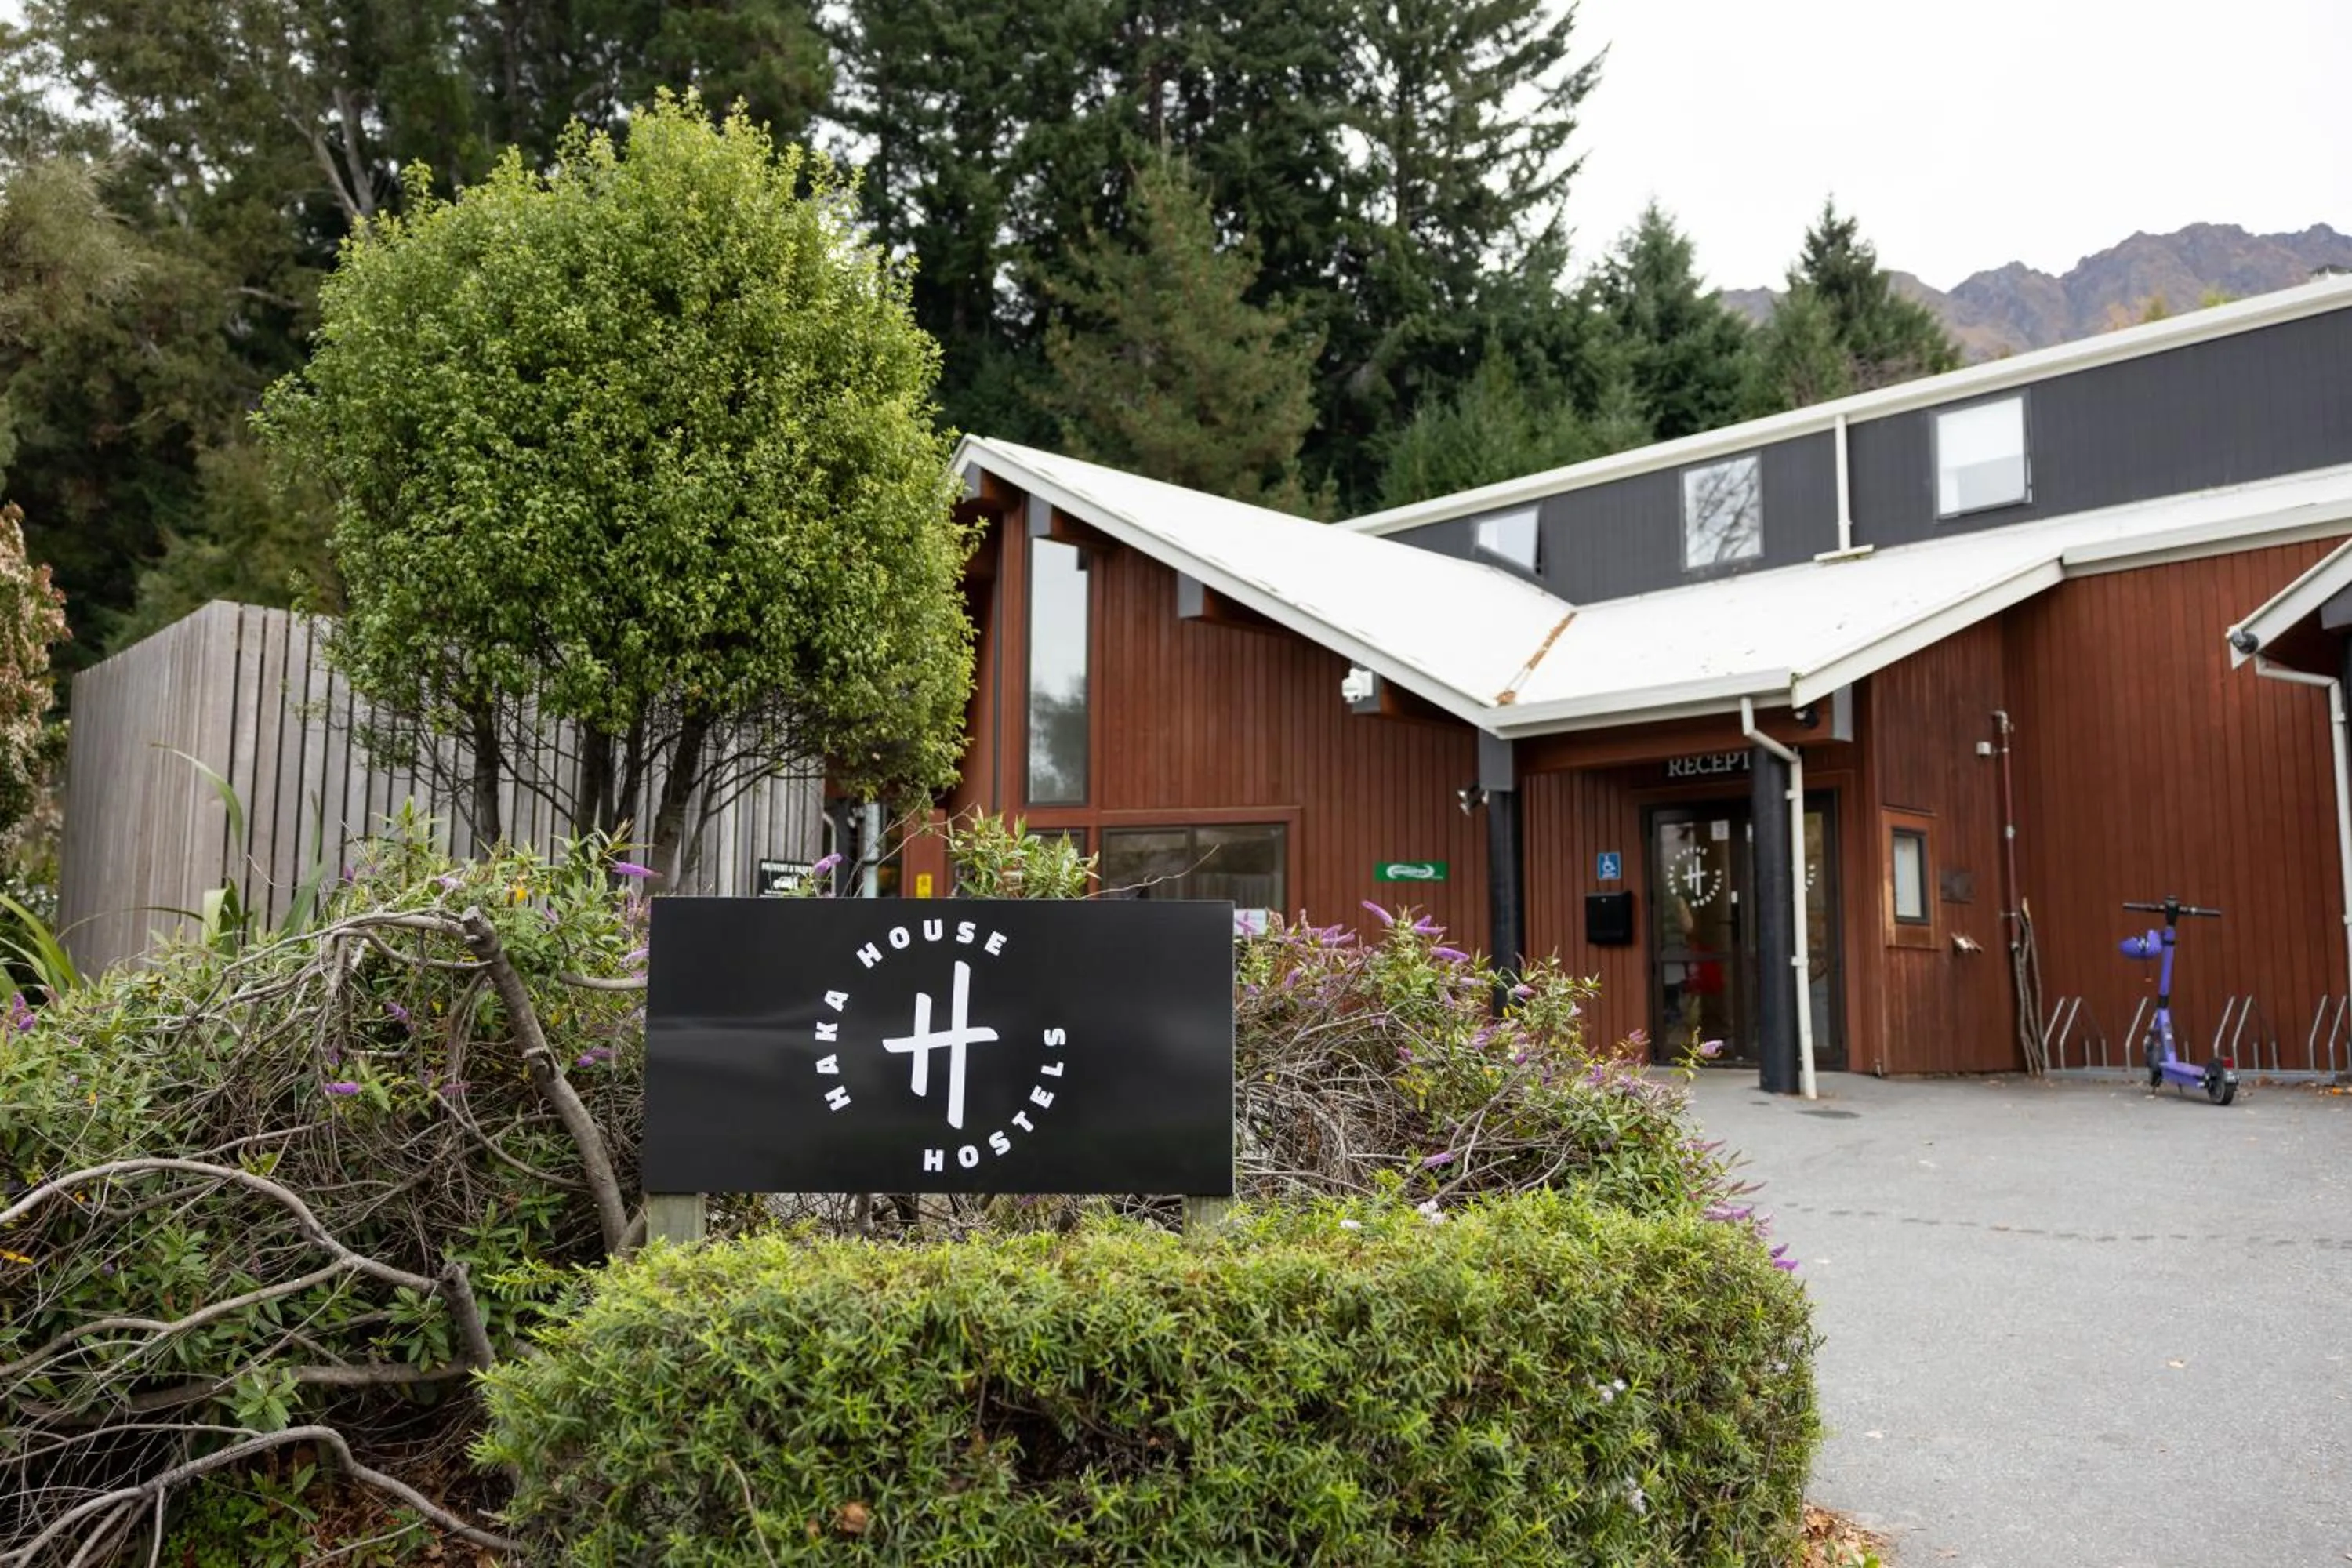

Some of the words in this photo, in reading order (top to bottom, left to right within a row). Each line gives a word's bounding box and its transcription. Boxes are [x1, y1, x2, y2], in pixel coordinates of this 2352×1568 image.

[1668, 751, 1750, 776] RECEPT
[815, 990, 851, 1111] HAKA
[856, 918, 1007, 969] HOUSE
[924, 1028, 1066, 1172] HOSTELS
